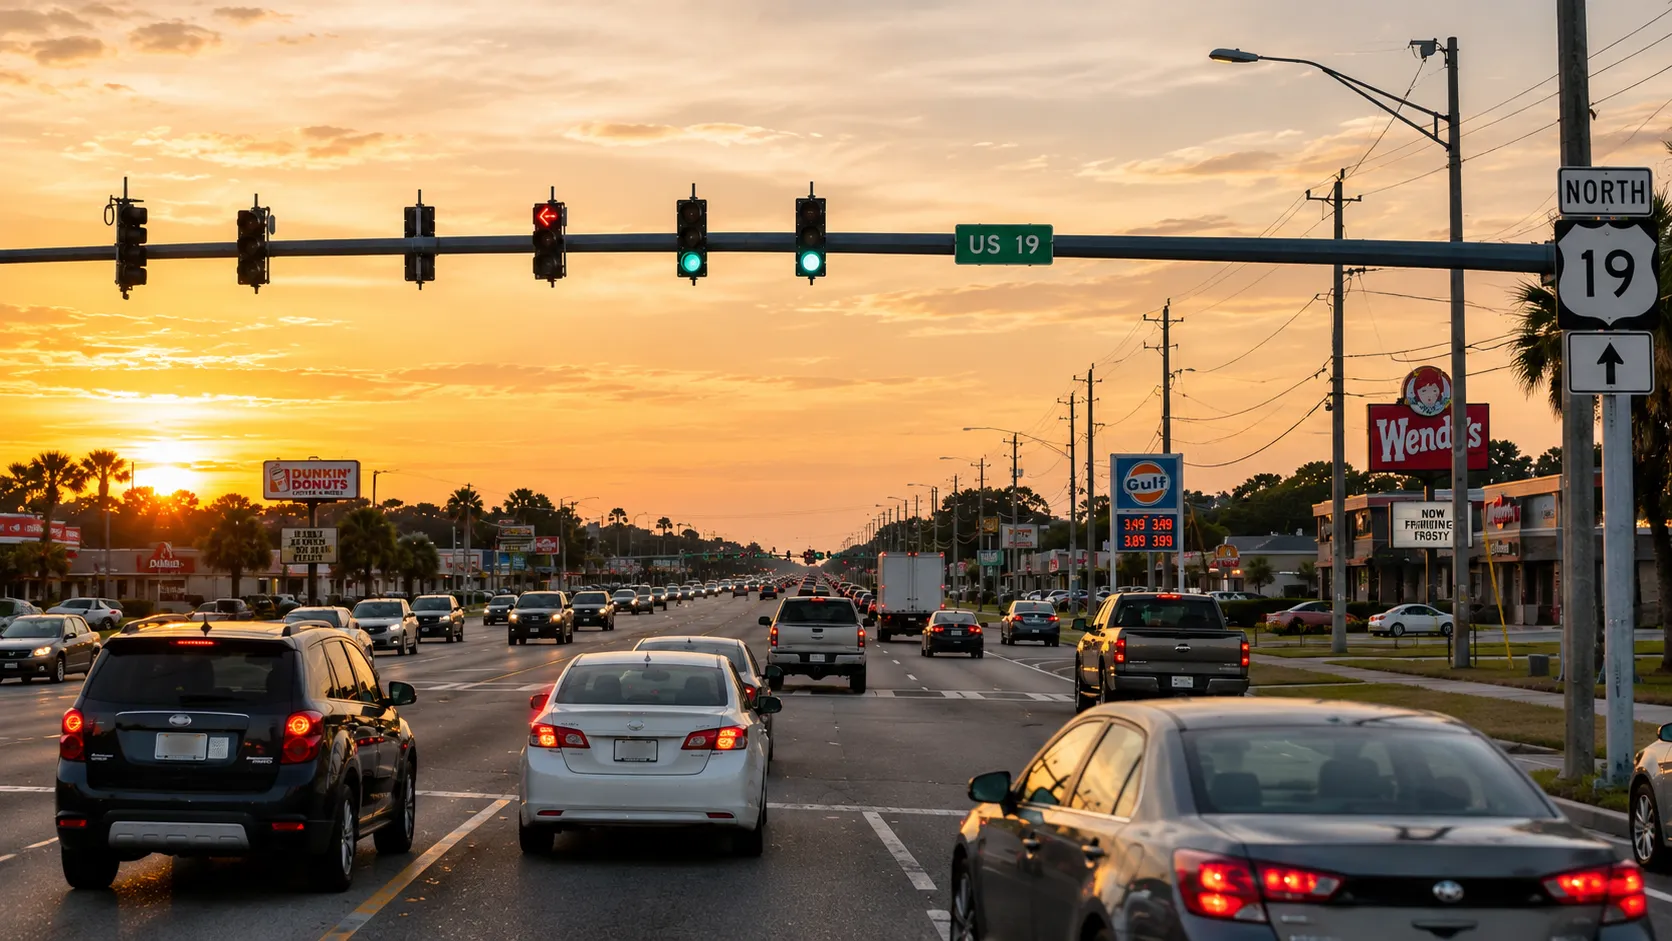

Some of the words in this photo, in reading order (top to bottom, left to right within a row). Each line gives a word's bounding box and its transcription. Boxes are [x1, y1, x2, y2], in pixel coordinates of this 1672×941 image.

[1566, 179, 1646, 205] NORTH
[969, 234, 1001, 255] US
[1016, 234, 1040, 255] 19
[1581, 249, 1635, 298] 19
[1376, 415, 1482, 462] Wend's
[291, 468, 351, 479] DUNKIN'
[291, 479, 348, 490] DONUTS
[1126, 476, 1167, 491] Gulf
[1421, 509, 1445, 518] NOW
[1124, 518, 1145, 531] 3.49
[1124, 534, 1146, 547] 3.89
